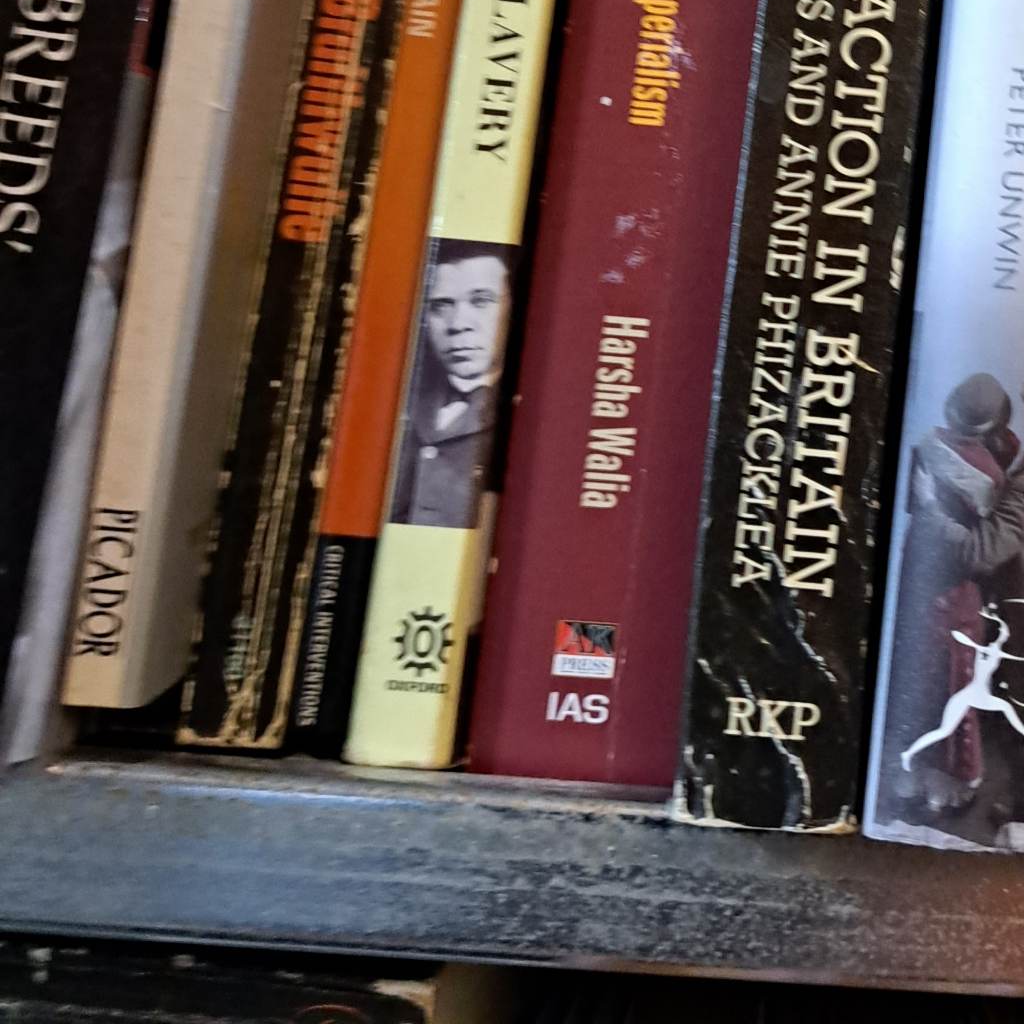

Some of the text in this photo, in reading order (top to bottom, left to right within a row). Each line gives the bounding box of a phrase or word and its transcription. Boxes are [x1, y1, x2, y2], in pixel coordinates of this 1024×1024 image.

[783, 29, 831, 128] AND
[766, 138, 818, 280] ANNIE
[811, 238, 869, 314] IN
[579, 313, 650, 510] Harsha Walia
[731, 292, 800, 590] PHIZACKLEA
[783, 328, 860, 598] BRITAIN
[76, 507, 140, 658] PICADOR
[295, 544, 346, 727] CRITICAL INTERVENTIONS
[545, 690, 610, 724] IAS
[724, 696, 822, 743] RKP
